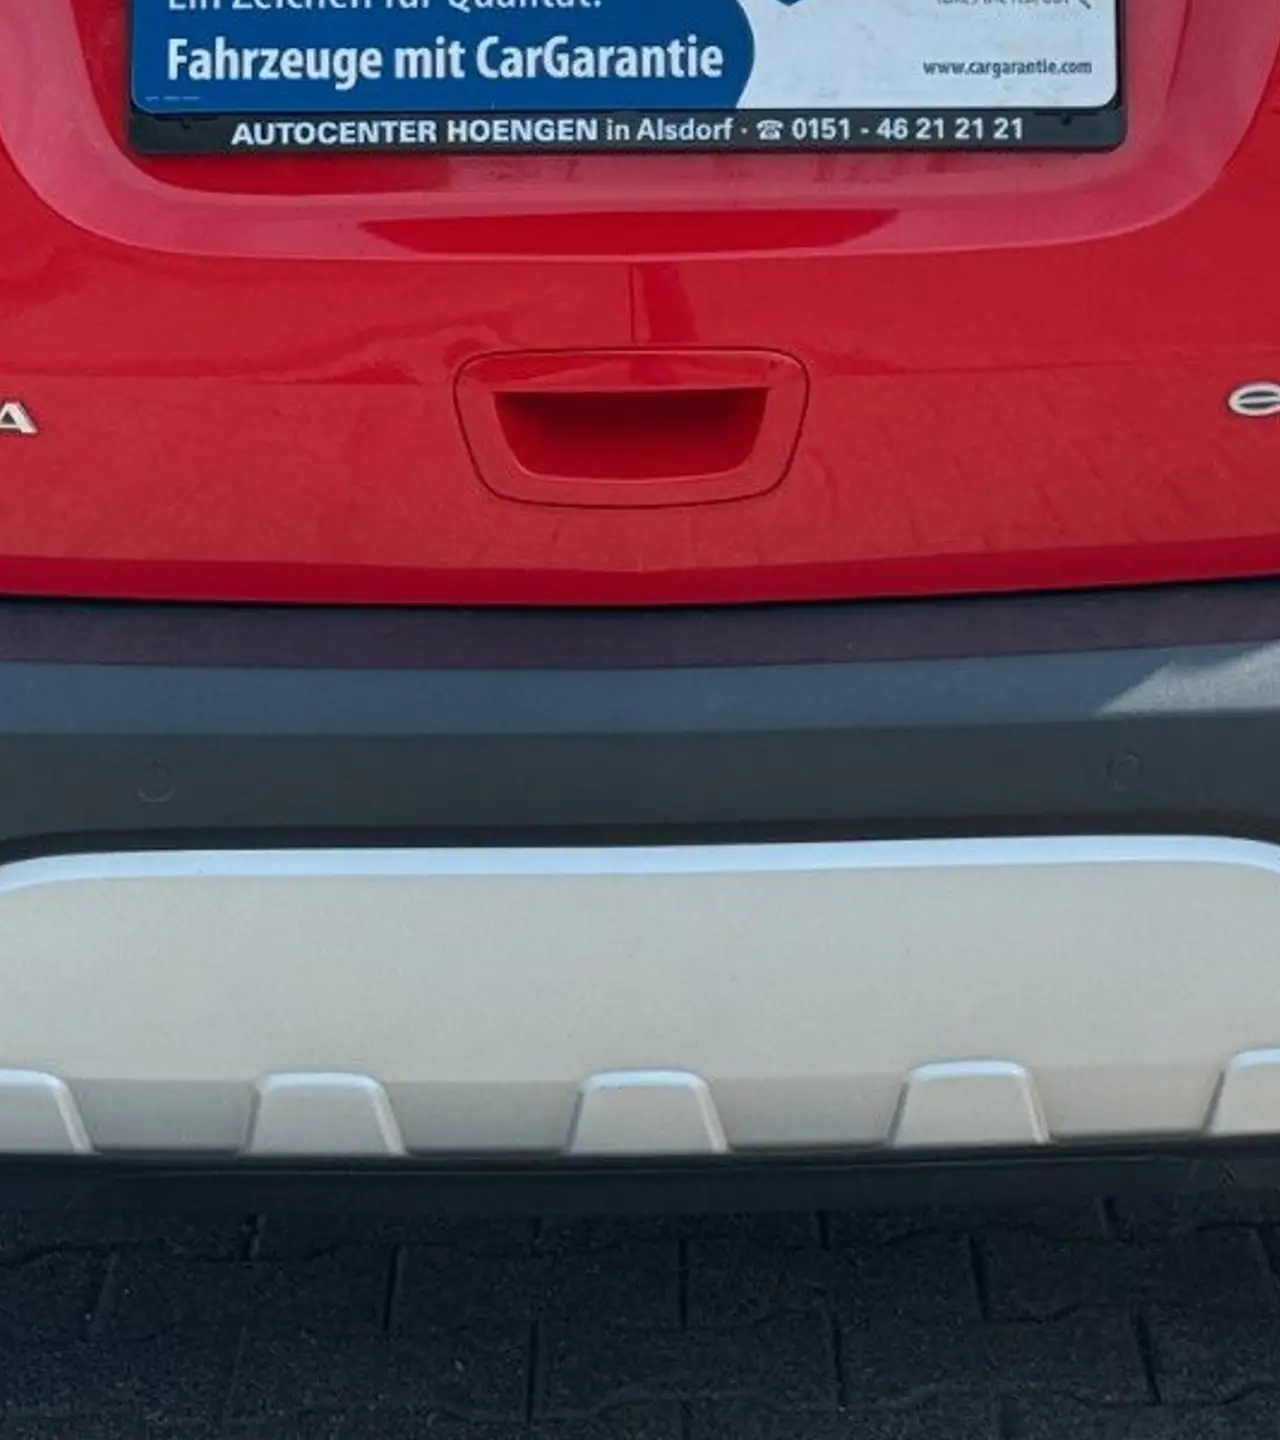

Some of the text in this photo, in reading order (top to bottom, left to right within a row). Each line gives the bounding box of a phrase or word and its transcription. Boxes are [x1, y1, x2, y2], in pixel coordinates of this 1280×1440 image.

[168, 34, 724, 91] Fahrzeuge mit CarGarantie
[922, 58, 1093, 79] www.cargarantie.com
[231, 120, 437, 146] AUTOCENTER
[447, 118, 598, 143] HOENGEN
[606, 118, 628, 141] in
[636, 116, 734, 141] Alsdorf
[791, 117, 850, 141] 0151
[876, 117, 909, 140] 46
[915, 117, 944, 140] 21
[954, 117, 983, 140] 21
[993, 117, 1023, 140] 21
